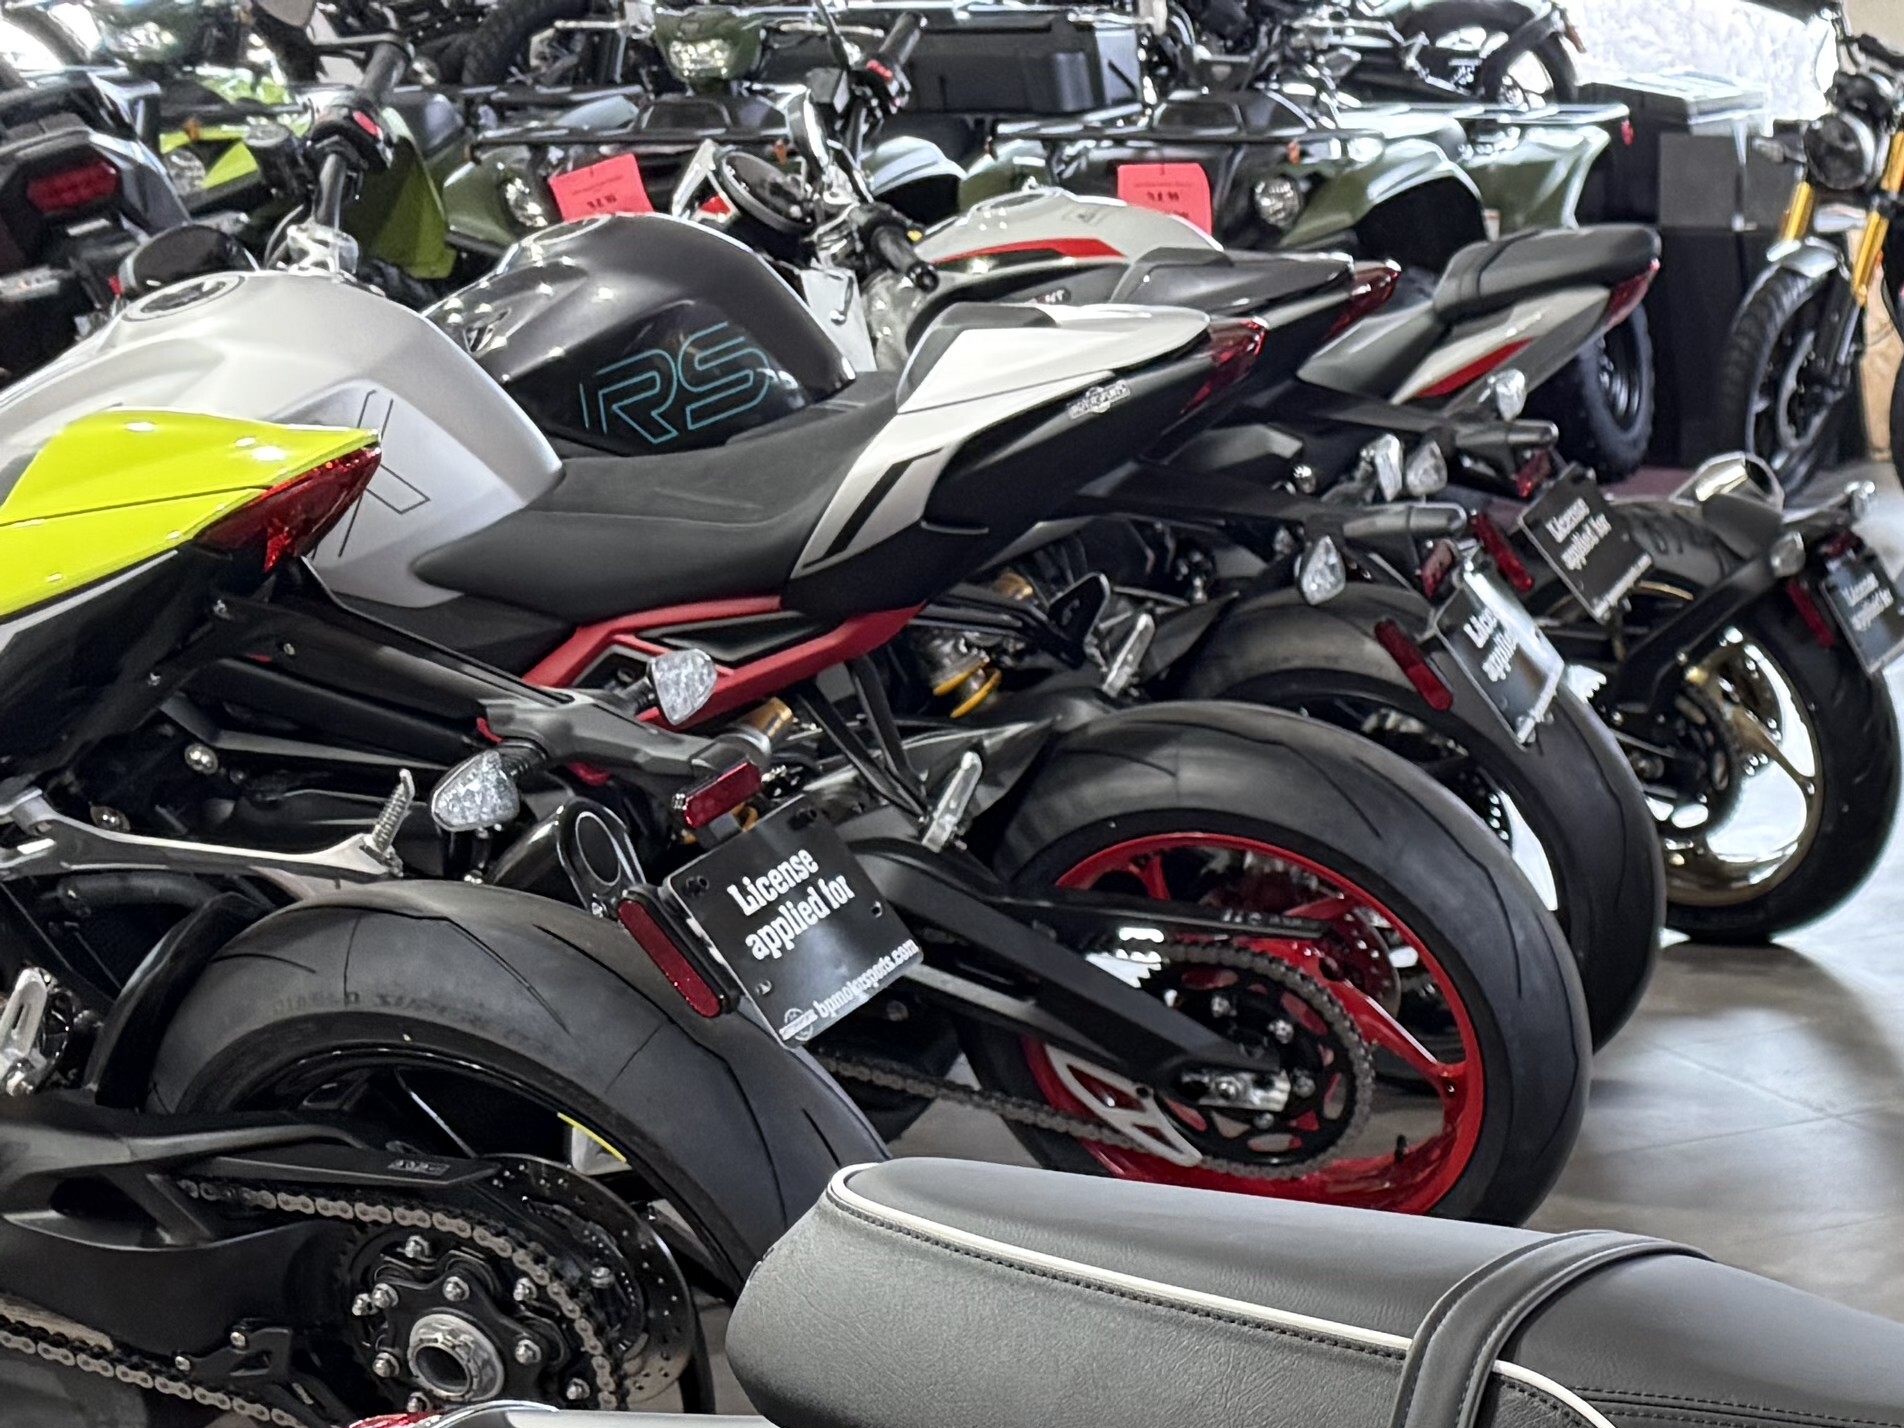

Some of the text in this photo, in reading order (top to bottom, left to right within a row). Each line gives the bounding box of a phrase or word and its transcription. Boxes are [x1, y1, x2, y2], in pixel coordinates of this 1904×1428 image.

[727, 849, 819, 916] License
[745, 875, 856, 960] applied for
